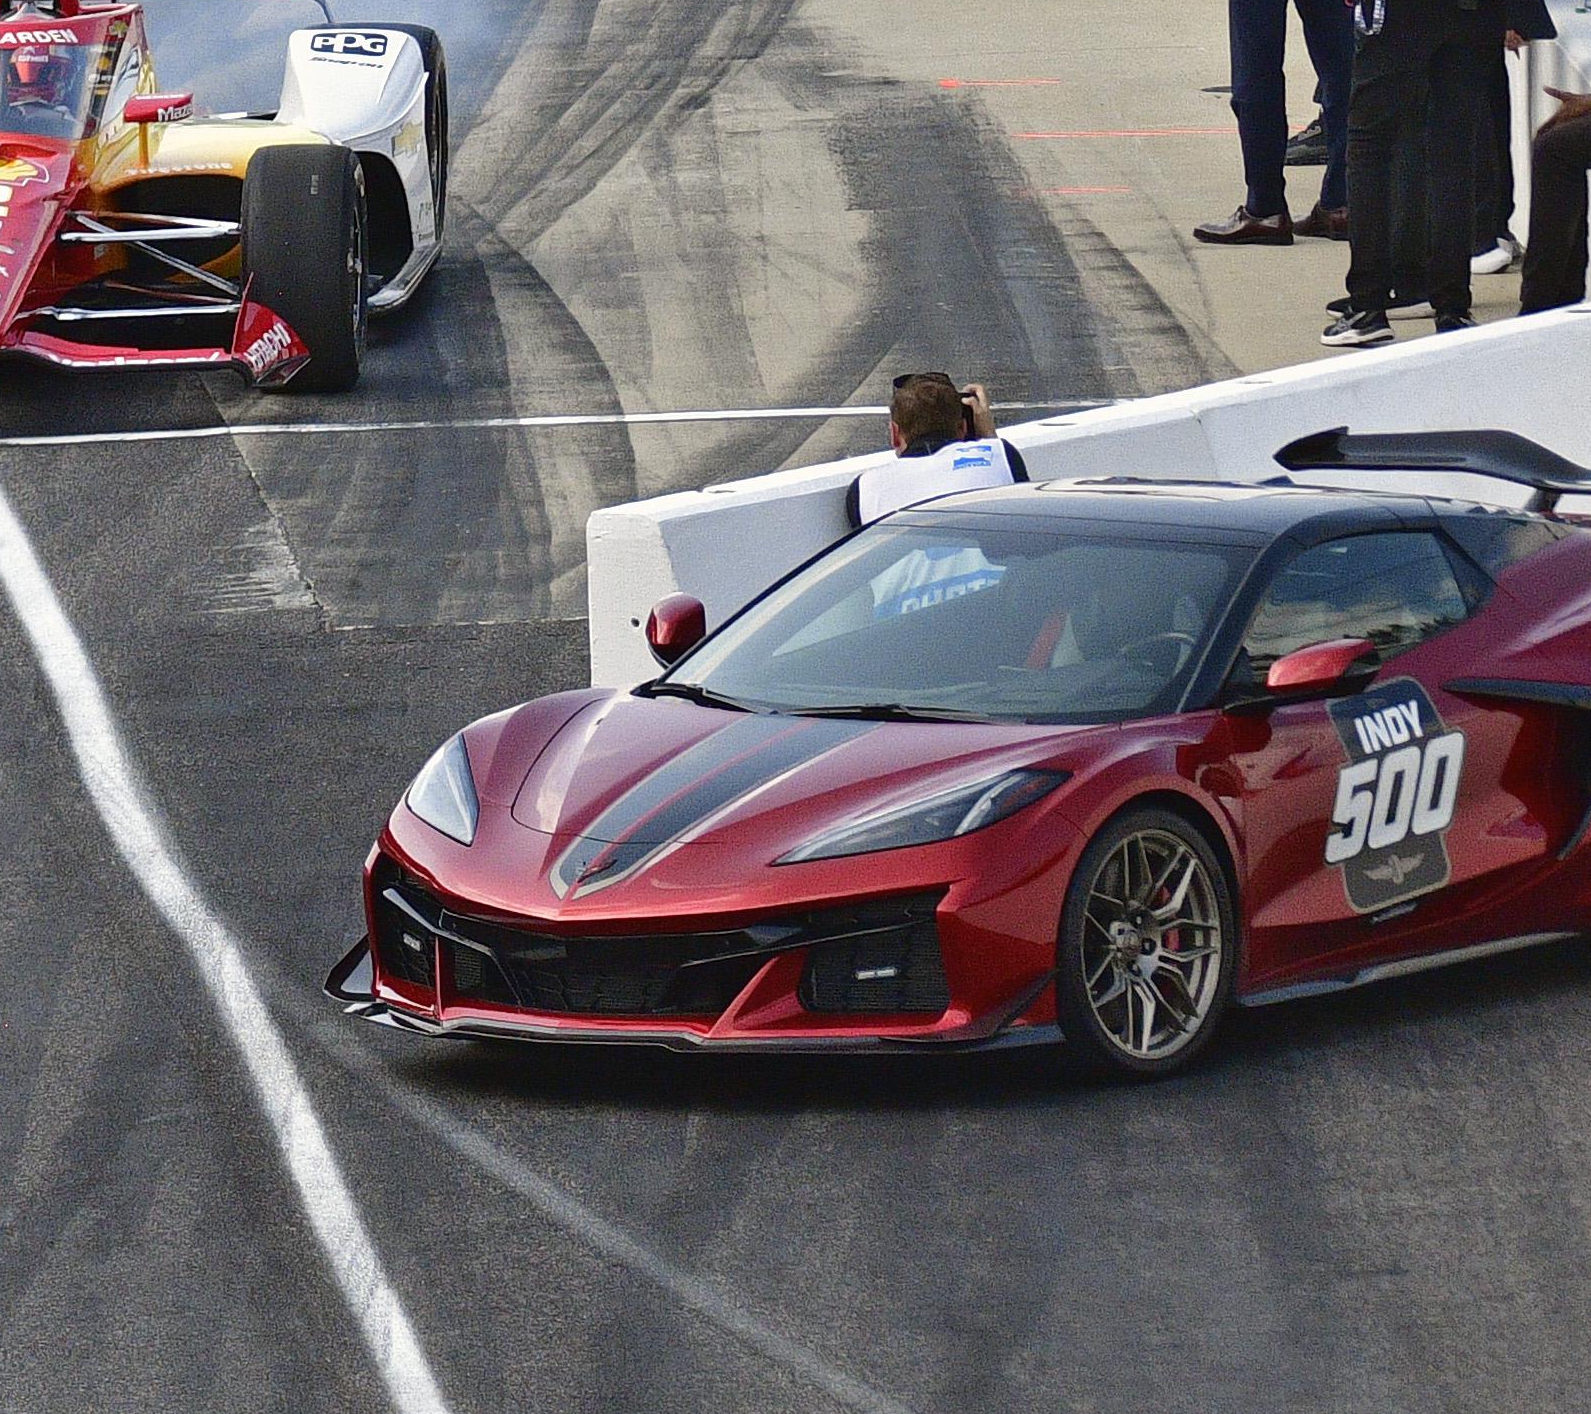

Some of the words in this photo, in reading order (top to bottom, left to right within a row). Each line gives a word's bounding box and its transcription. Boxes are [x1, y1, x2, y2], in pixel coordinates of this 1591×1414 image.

[313, 32, 387, 56] PPG
[244, 324, 291, 372] HITACHI
[1353, 698, 1424, 755] INDY
[1324, 731, 1465, 864] 500
